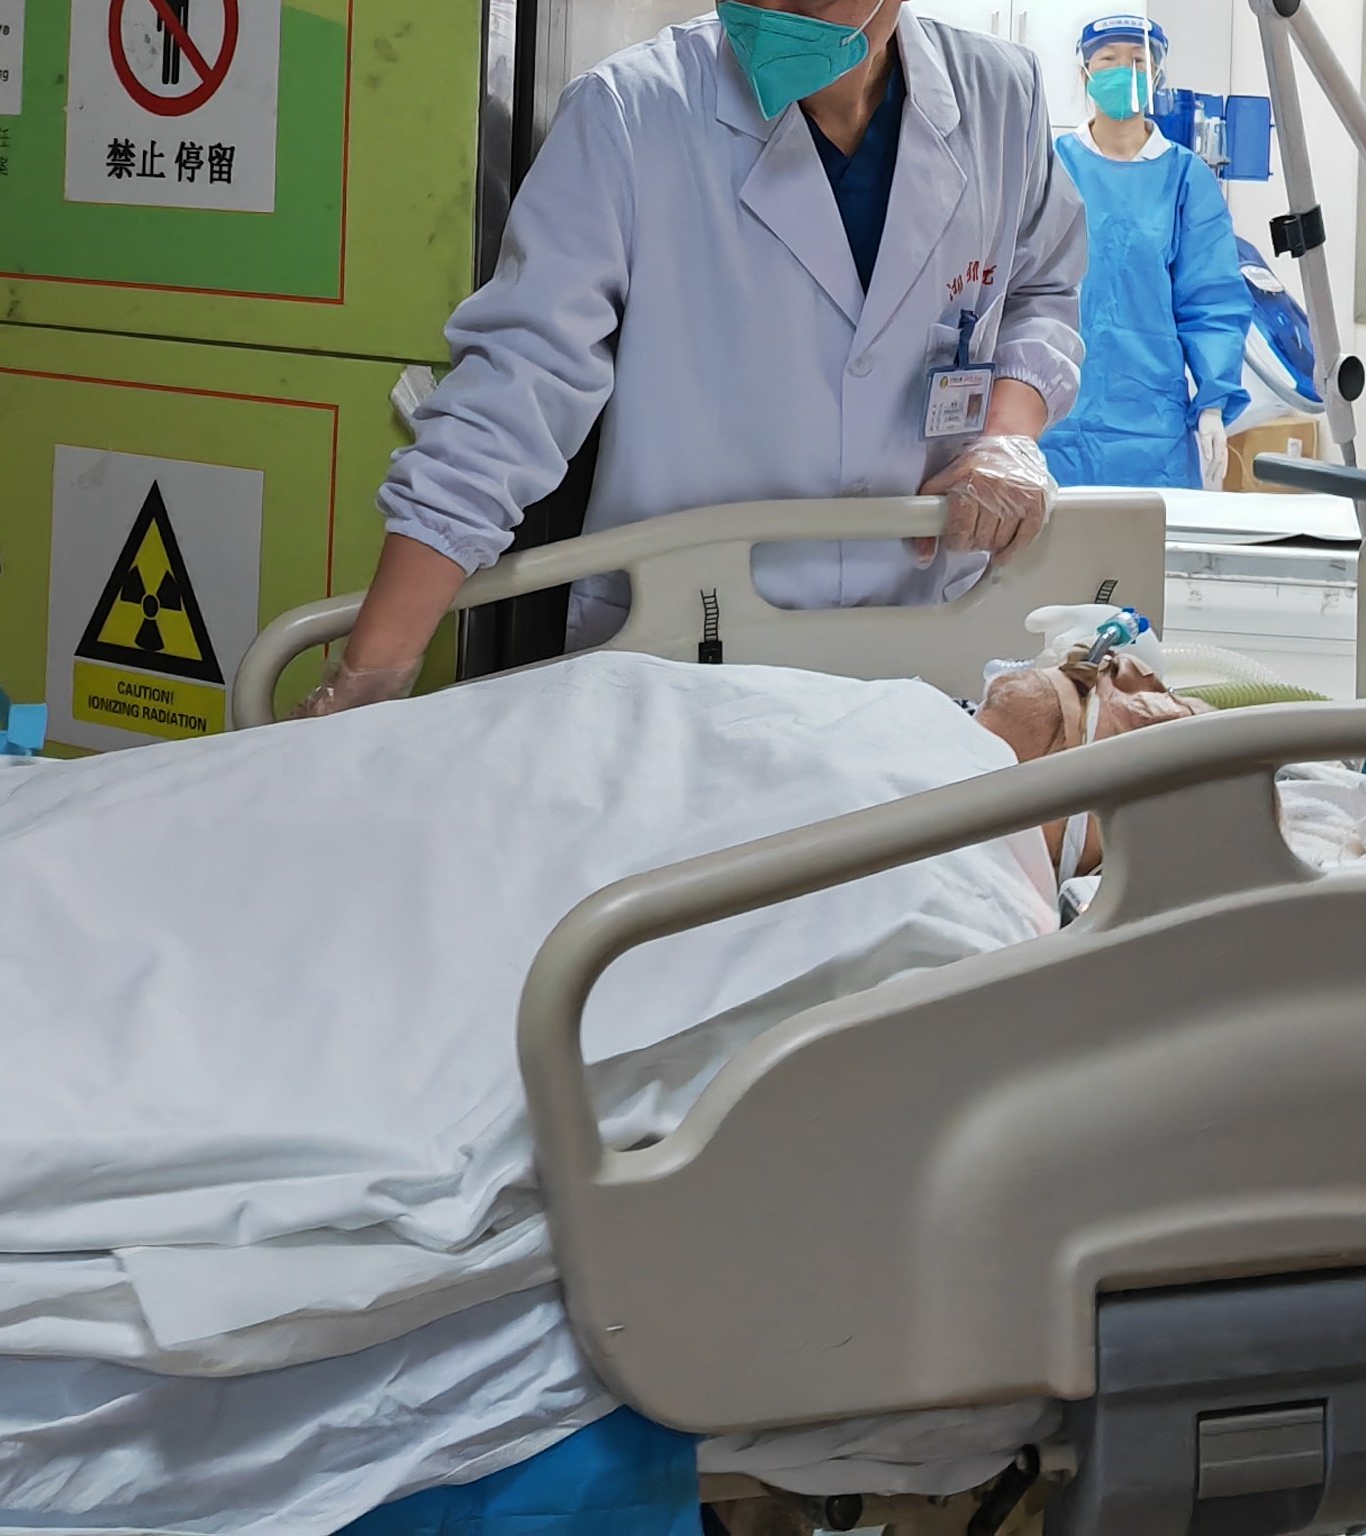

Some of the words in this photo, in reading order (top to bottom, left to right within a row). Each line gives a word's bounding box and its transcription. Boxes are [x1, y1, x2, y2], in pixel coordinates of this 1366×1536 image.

[105, 136, 236, 185] 禁止停留
[117, 681, 175, 706] CAUTION!
[88, 695, 140, 718] IONIZING
[142, 706, 207, 734] RADIATION
